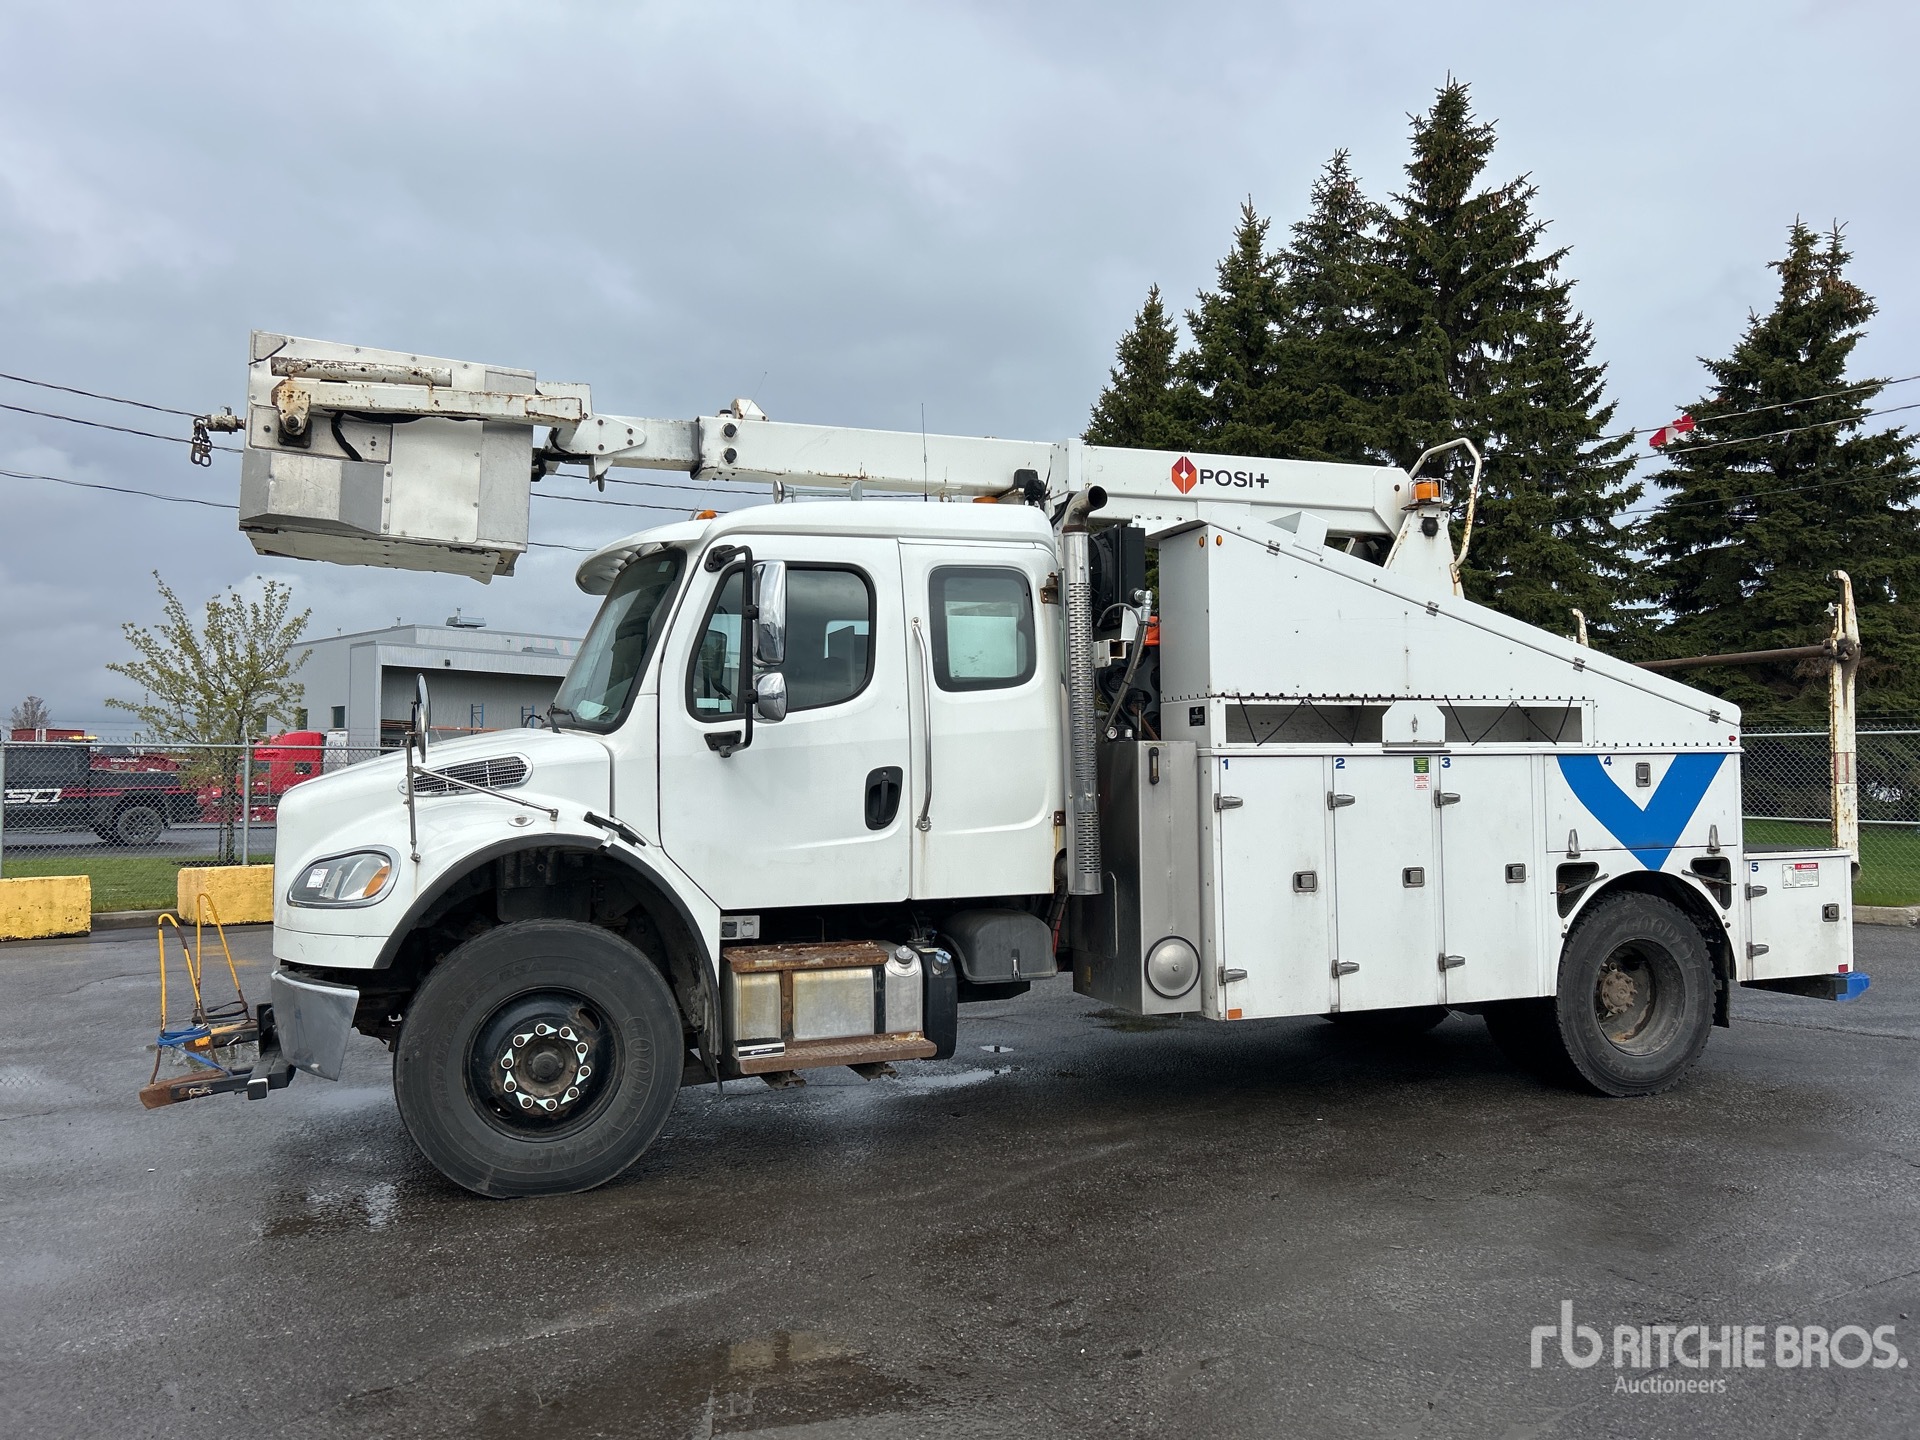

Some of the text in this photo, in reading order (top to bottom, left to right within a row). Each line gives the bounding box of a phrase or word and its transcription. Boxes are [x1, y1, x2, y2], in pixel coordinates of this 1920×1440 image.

[1222, 758, 1229, 770] 1
[1335, 757, 1345, 769] 2
[1441, 757, 1451, 768] 3
[1603, 755, 1612, 766] 4
[1751, 862, 1759, 872] 5
